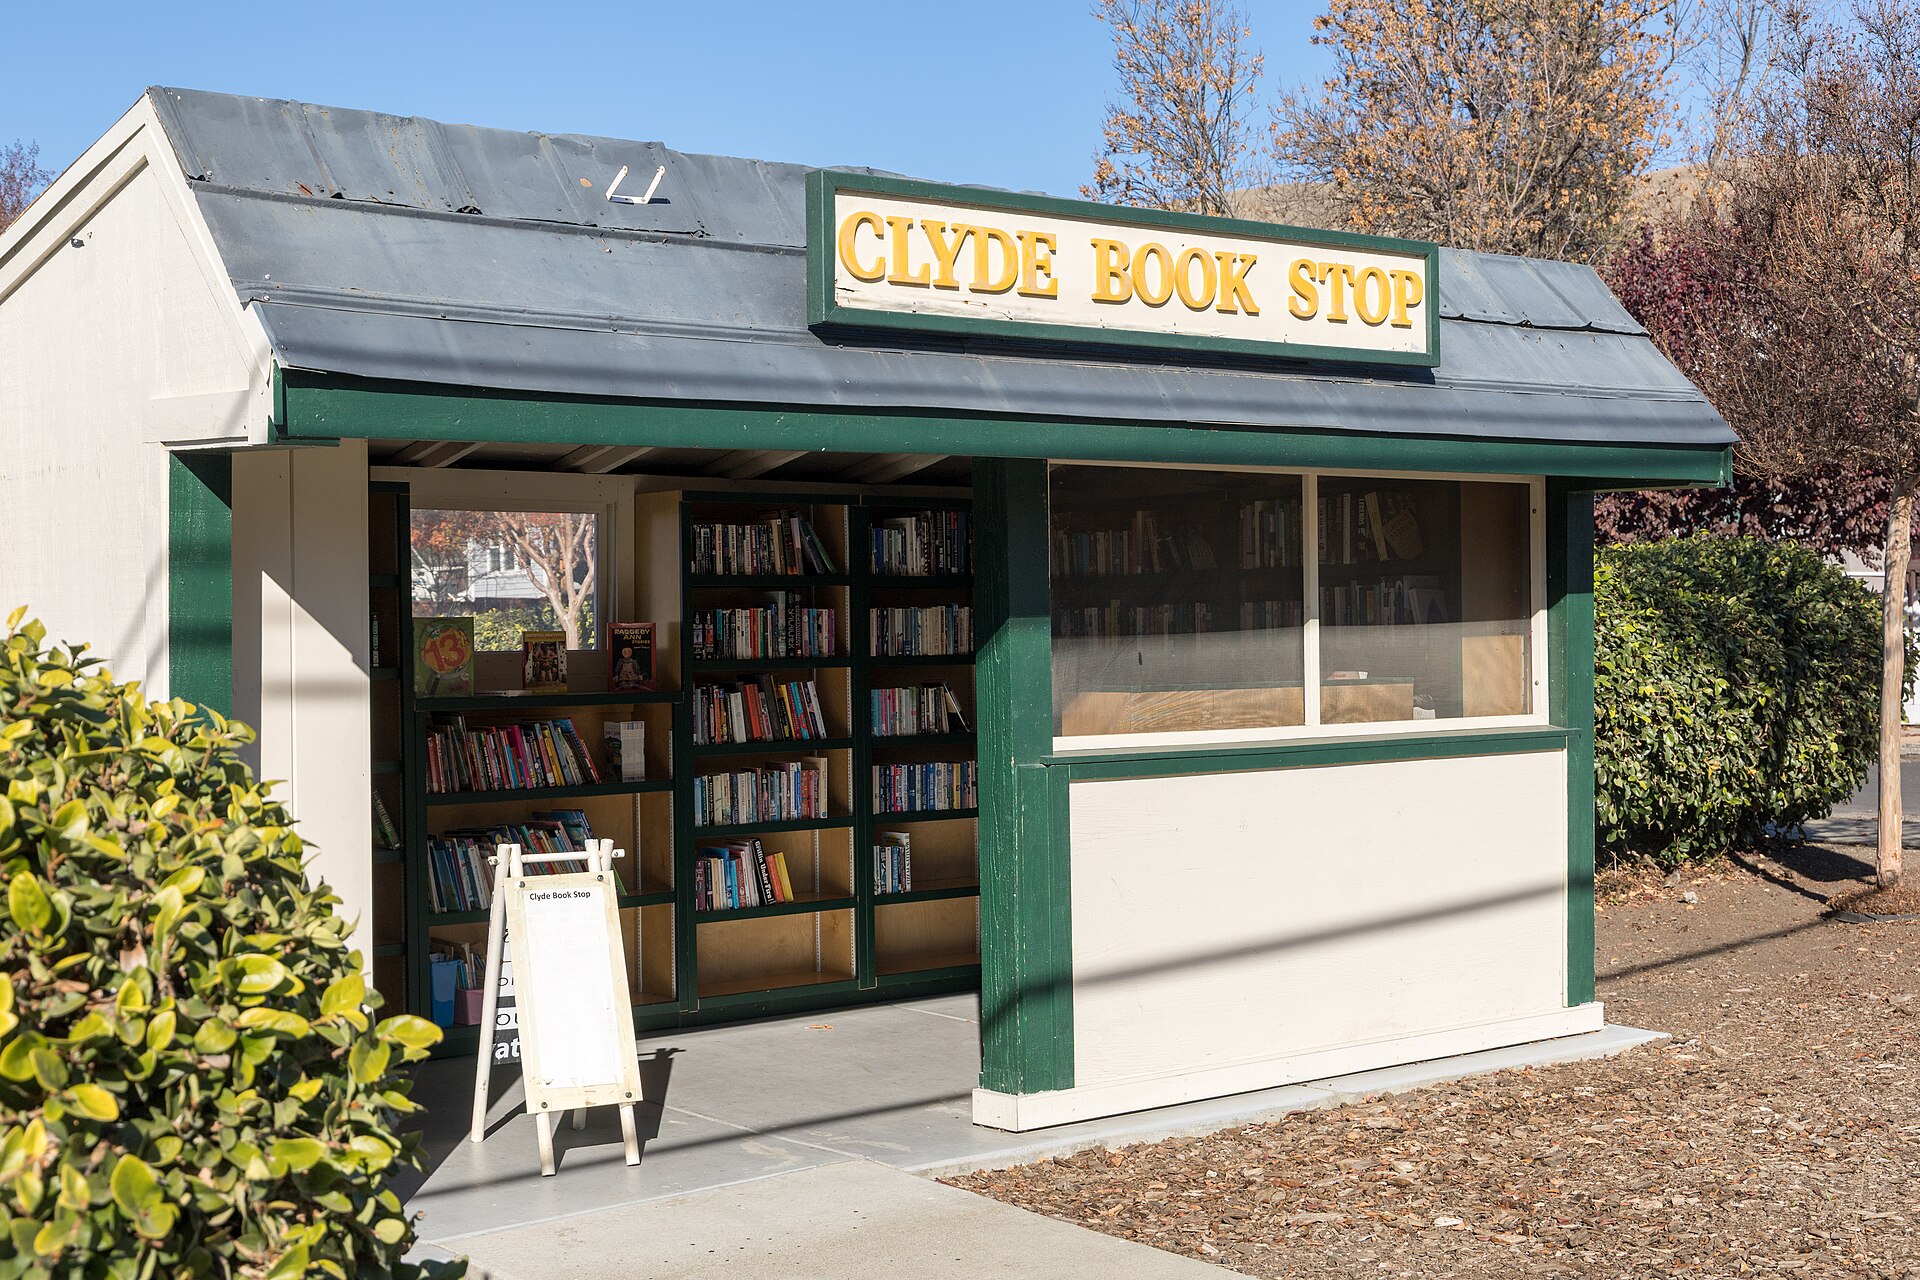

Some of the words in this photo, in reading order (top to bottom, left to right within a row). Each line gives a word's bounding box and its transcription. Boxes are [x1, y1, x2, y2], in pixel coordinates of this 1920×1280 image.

[838, 210, 1059, 300] CLYDE
[1090, 237, 1260, 317] BOOK
[1288, 258, 1424, 330] STOP
[423, 633, 466, 672] 13
[529, 891, 551, 902] Clyde
[552, 890, 572, 900] Book
[573, 889, 591, 900] Stop
